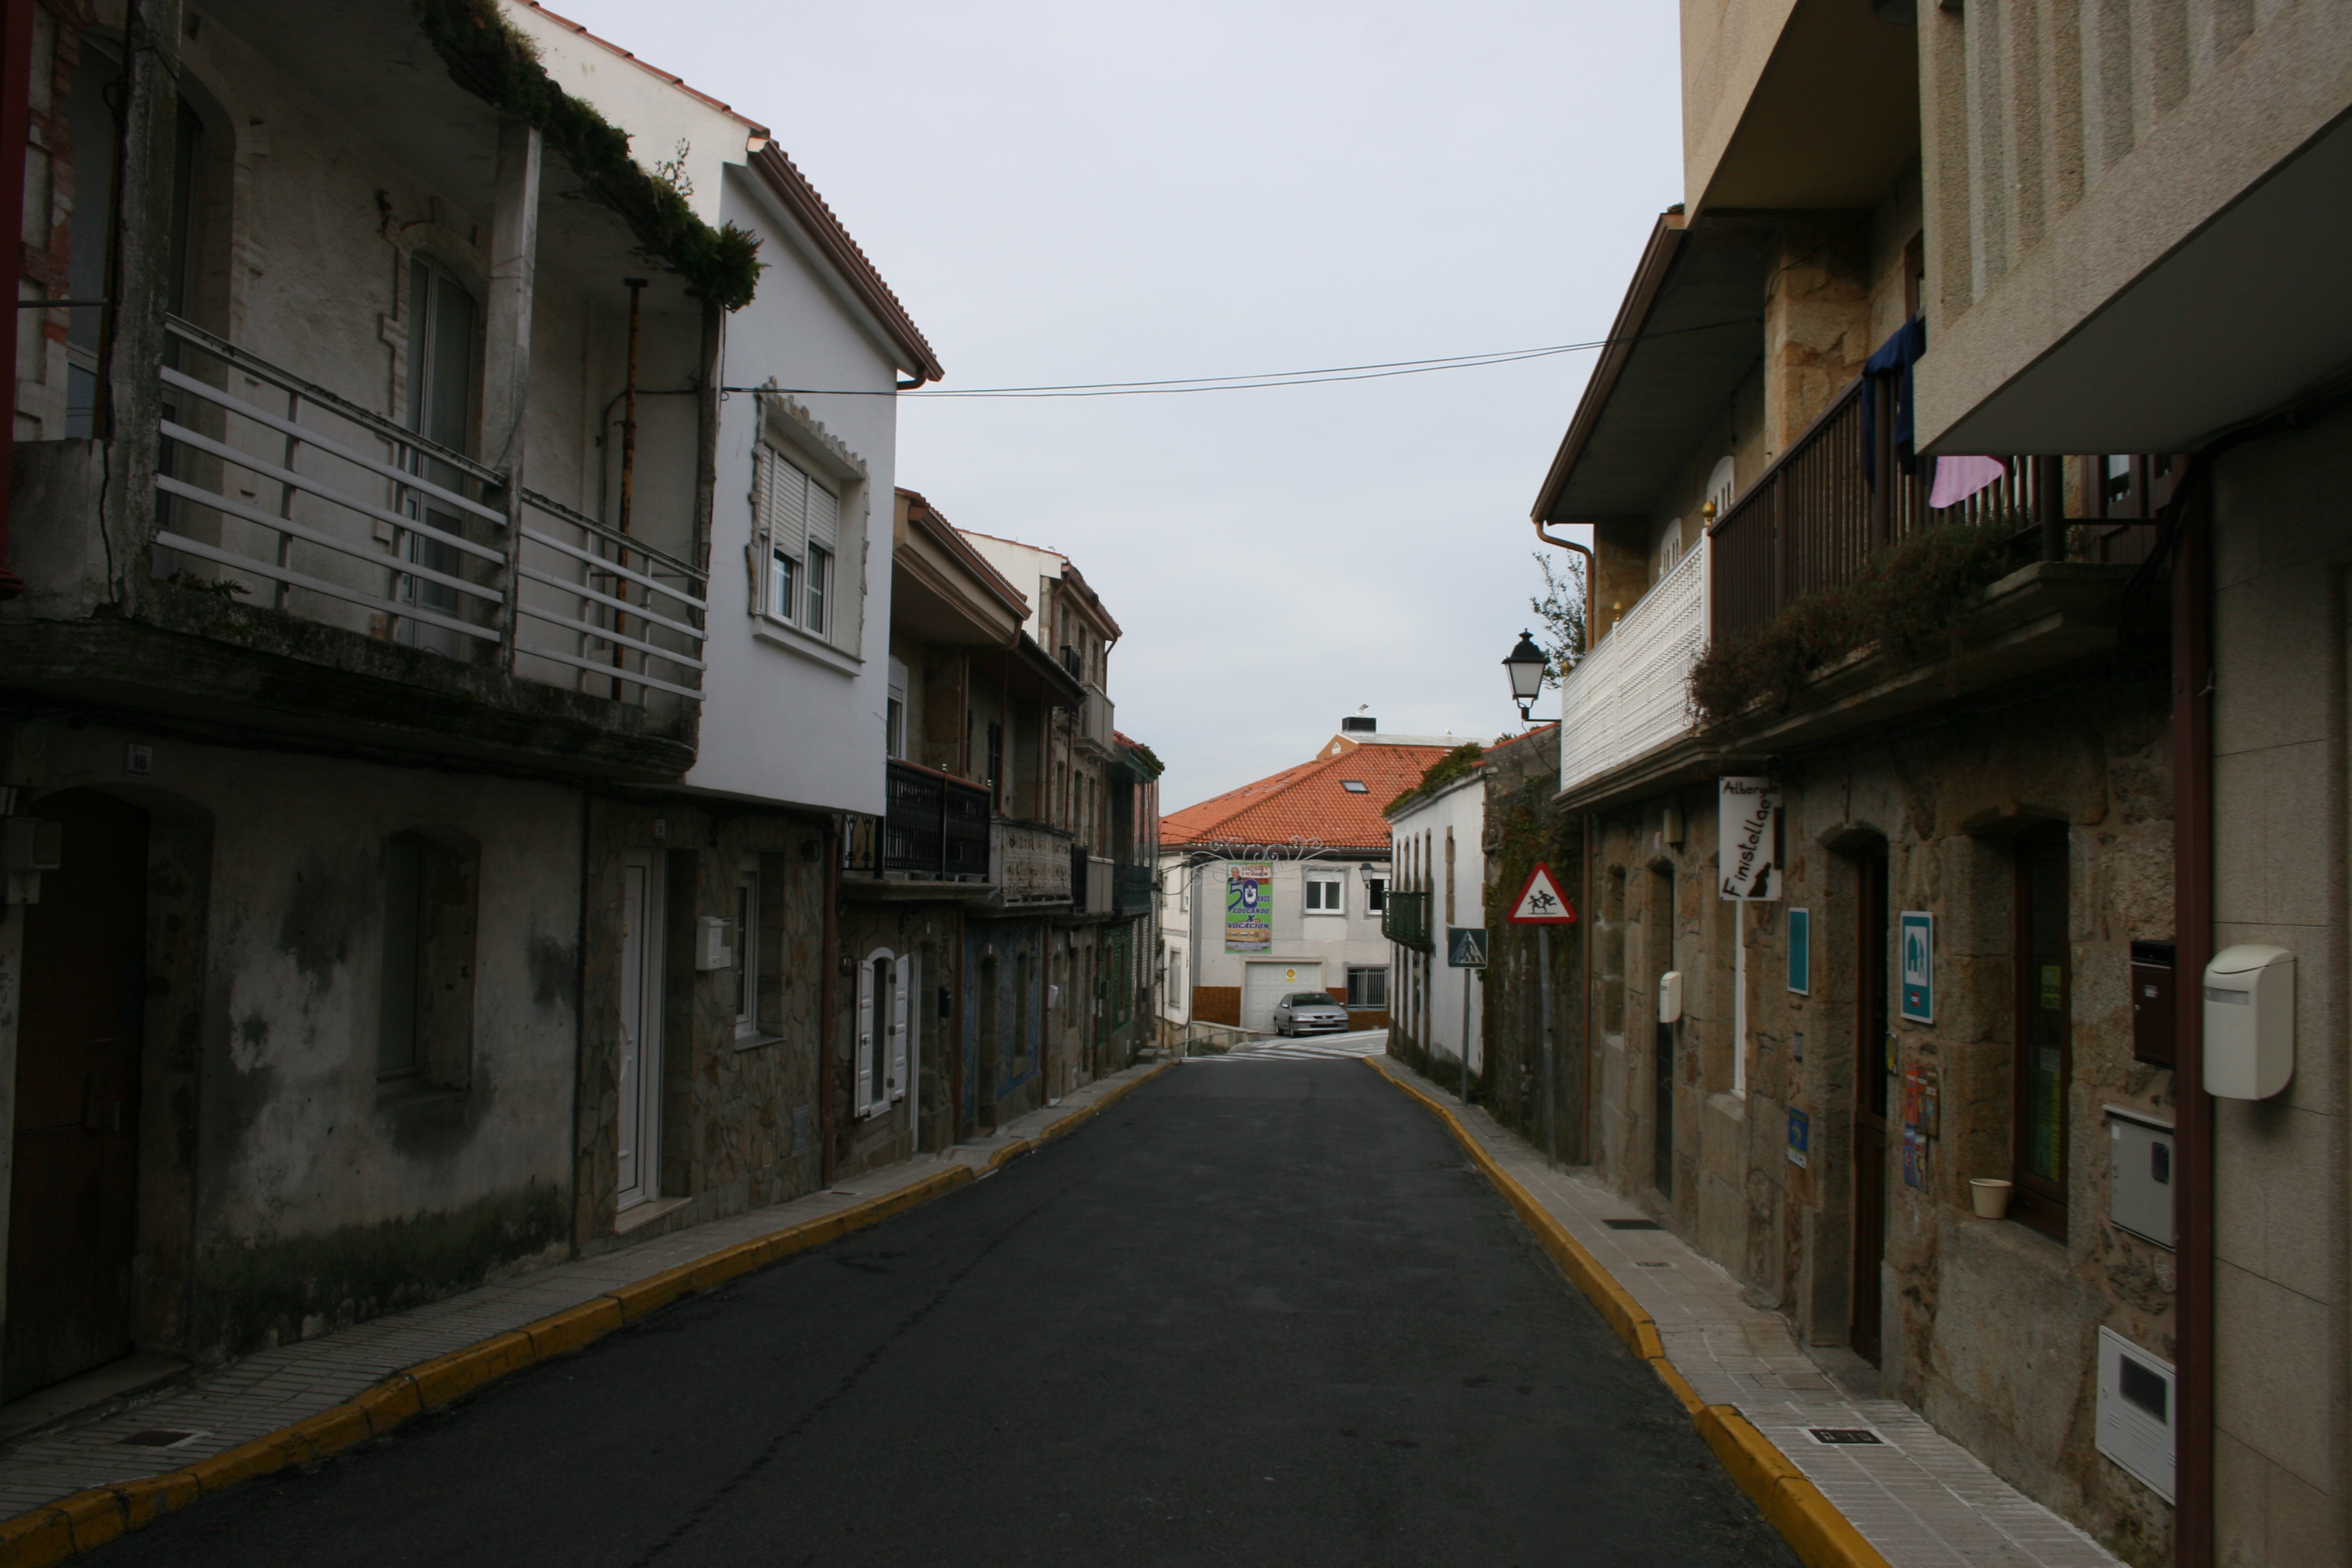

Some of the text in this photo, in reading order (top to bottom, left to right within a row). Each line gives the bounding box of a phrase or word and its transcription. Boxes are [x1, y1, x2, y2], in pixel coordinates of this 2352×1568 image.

[133, 754, 146, 769] 16
[1722, 780, 1778, 798] Albergue
[1228, 879, 1257, 912] 50
